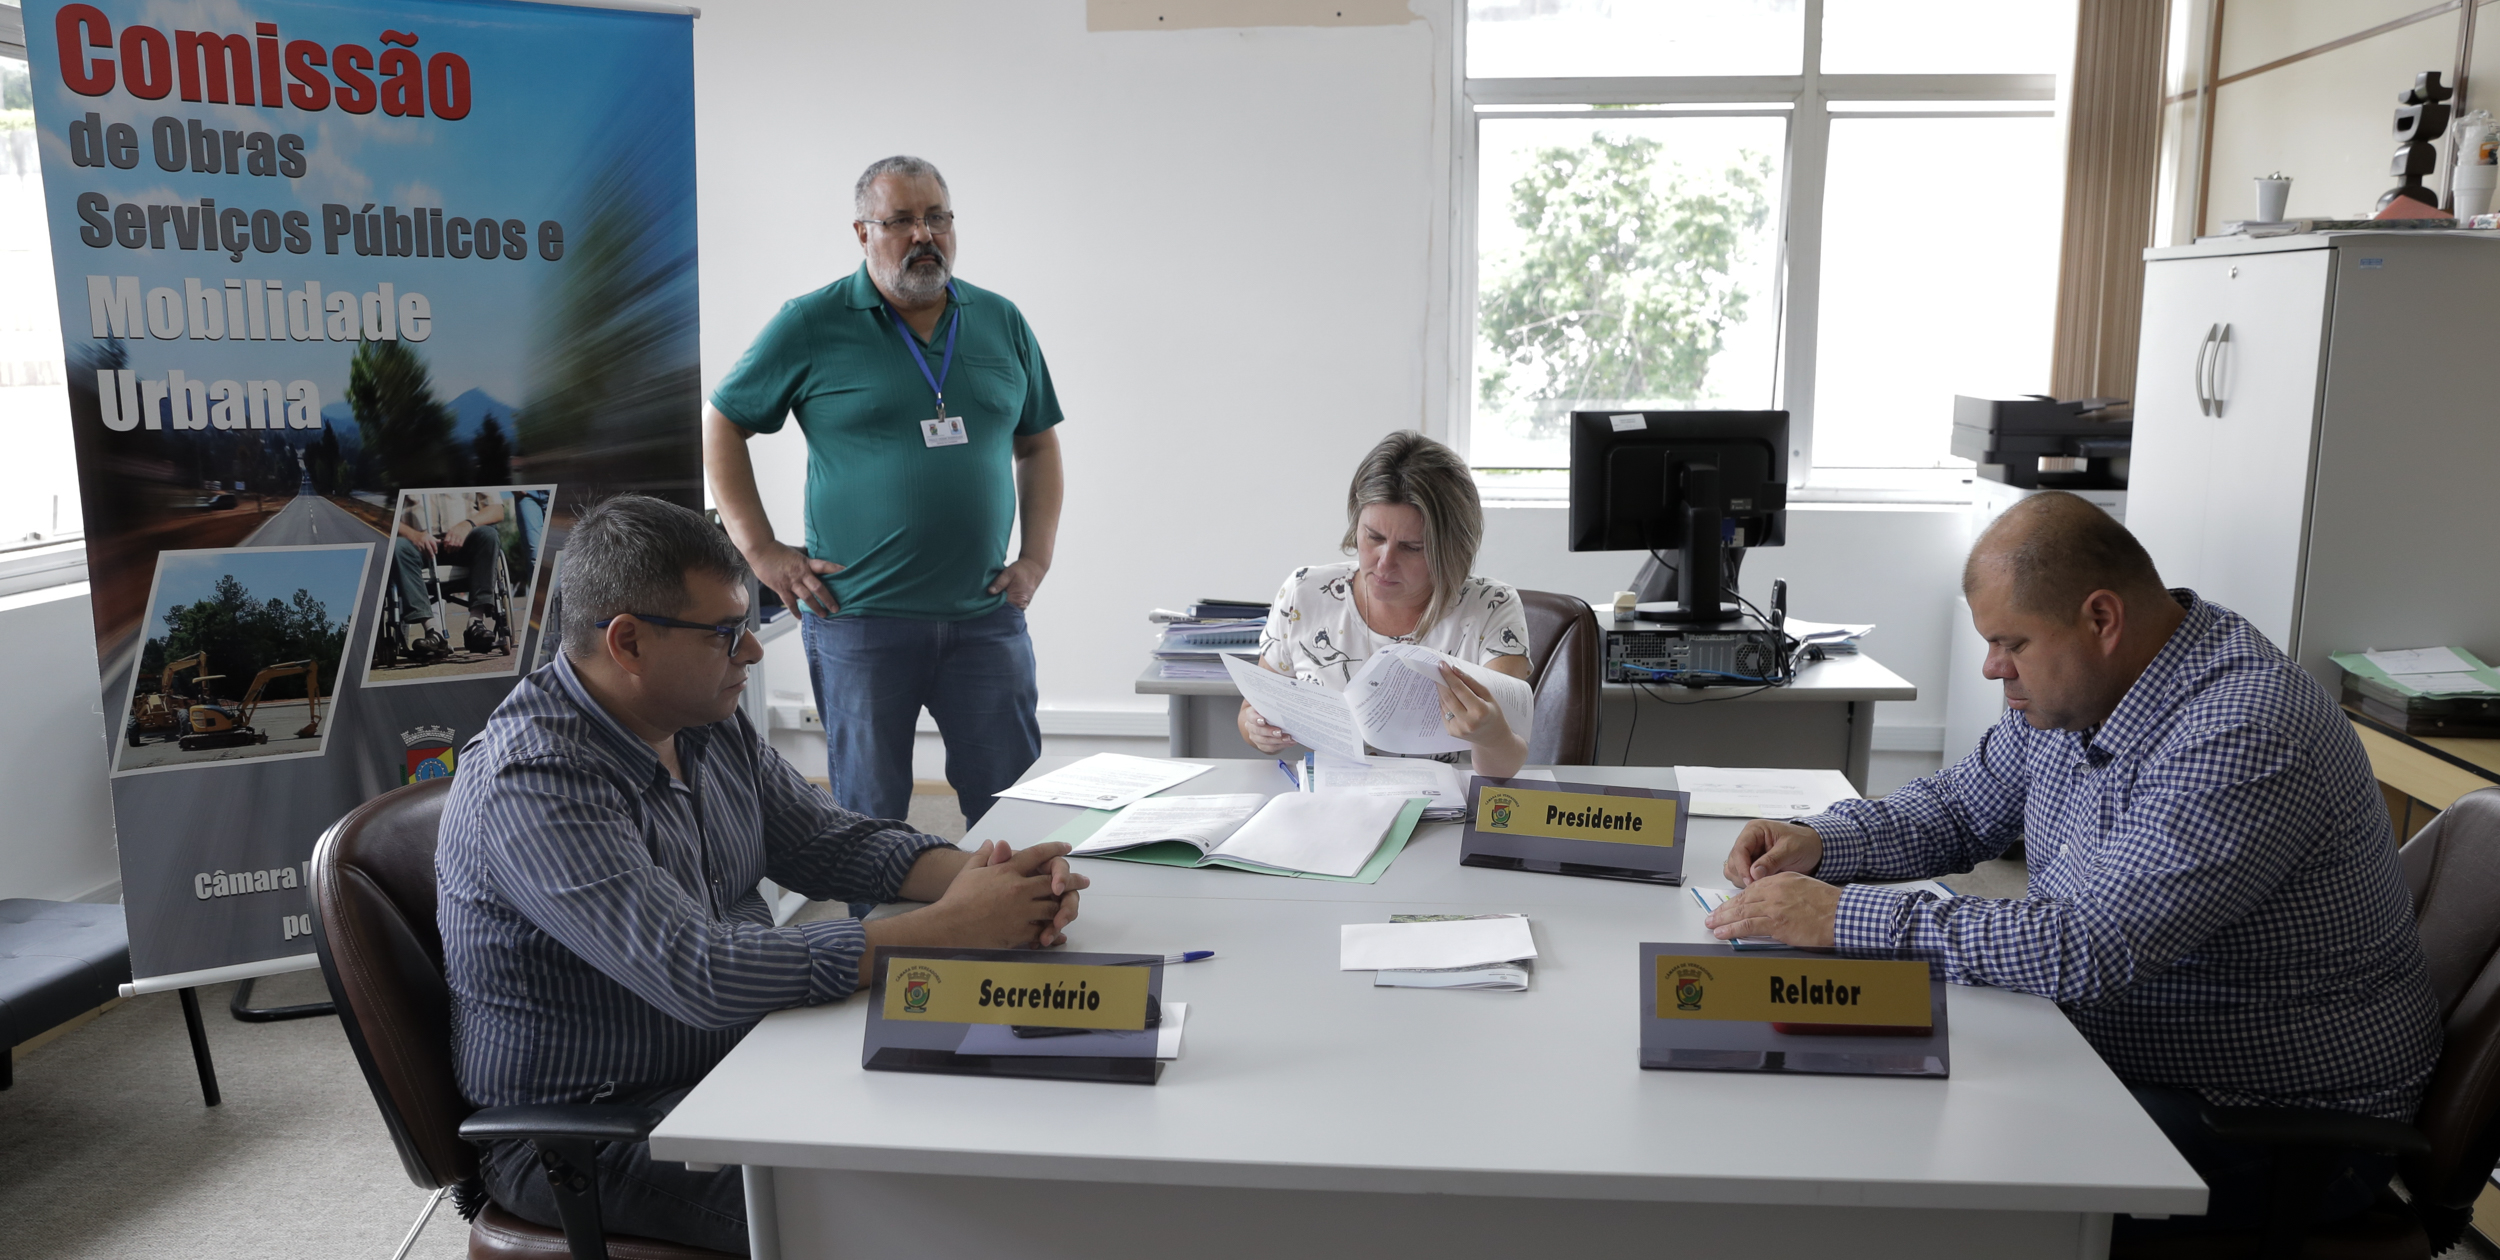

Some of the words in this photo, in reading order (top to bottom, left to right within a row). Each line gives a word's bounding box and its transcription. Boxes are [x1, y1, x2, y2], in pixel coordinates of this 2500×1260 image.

[55, 3, 472, 121] Comissão
[69, 112, 139, 170] de
[152, 115, 307, 178] Obras
[76, 191, 311, 262] Serviços
[324, 203, 528, 261] Públicos
[538, 218, 564, 261] e
[86, 275, 432, 343] Mobilidade
[97, 368, 322, 432] Urbana
[1545, 804, 1643, 832] Presidente
[194, 866, 298, 901] Câmara
[978, 978, 1100, 1011] Secretário
[1770, 974, 1861, 1006] Relator
